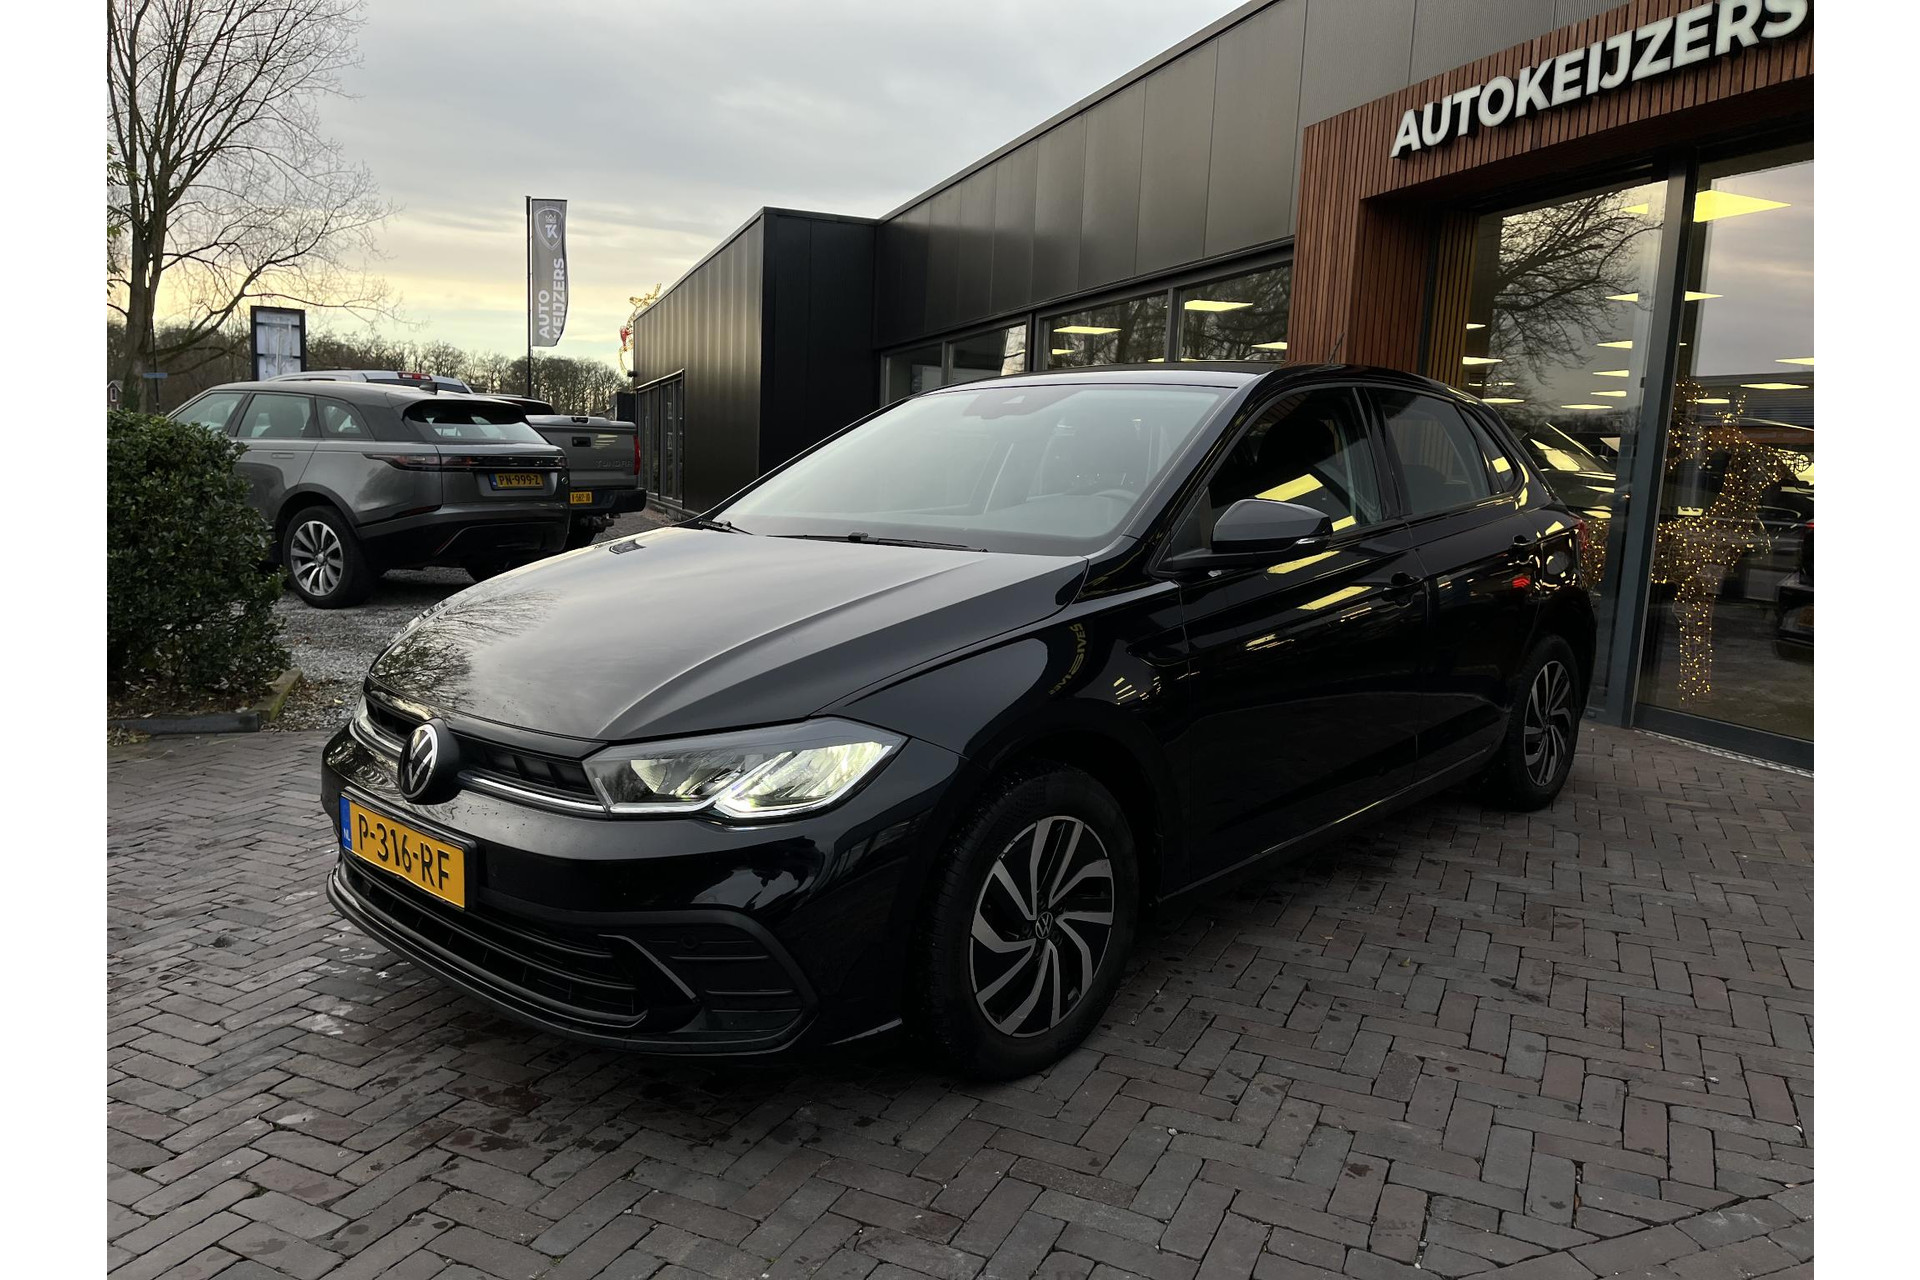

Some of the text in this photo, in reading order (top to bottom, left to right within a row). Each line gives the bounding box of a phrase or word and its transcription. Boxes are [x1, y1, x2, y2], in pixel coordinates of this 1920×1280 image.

[1390, 0, 1808, 159] AUTOKEIJZERS
[538, 289, 550, 339] AUTO
[498, 474, 540, 486] PN-999-Z
[358, 813, 450, 891] P-316-RF
